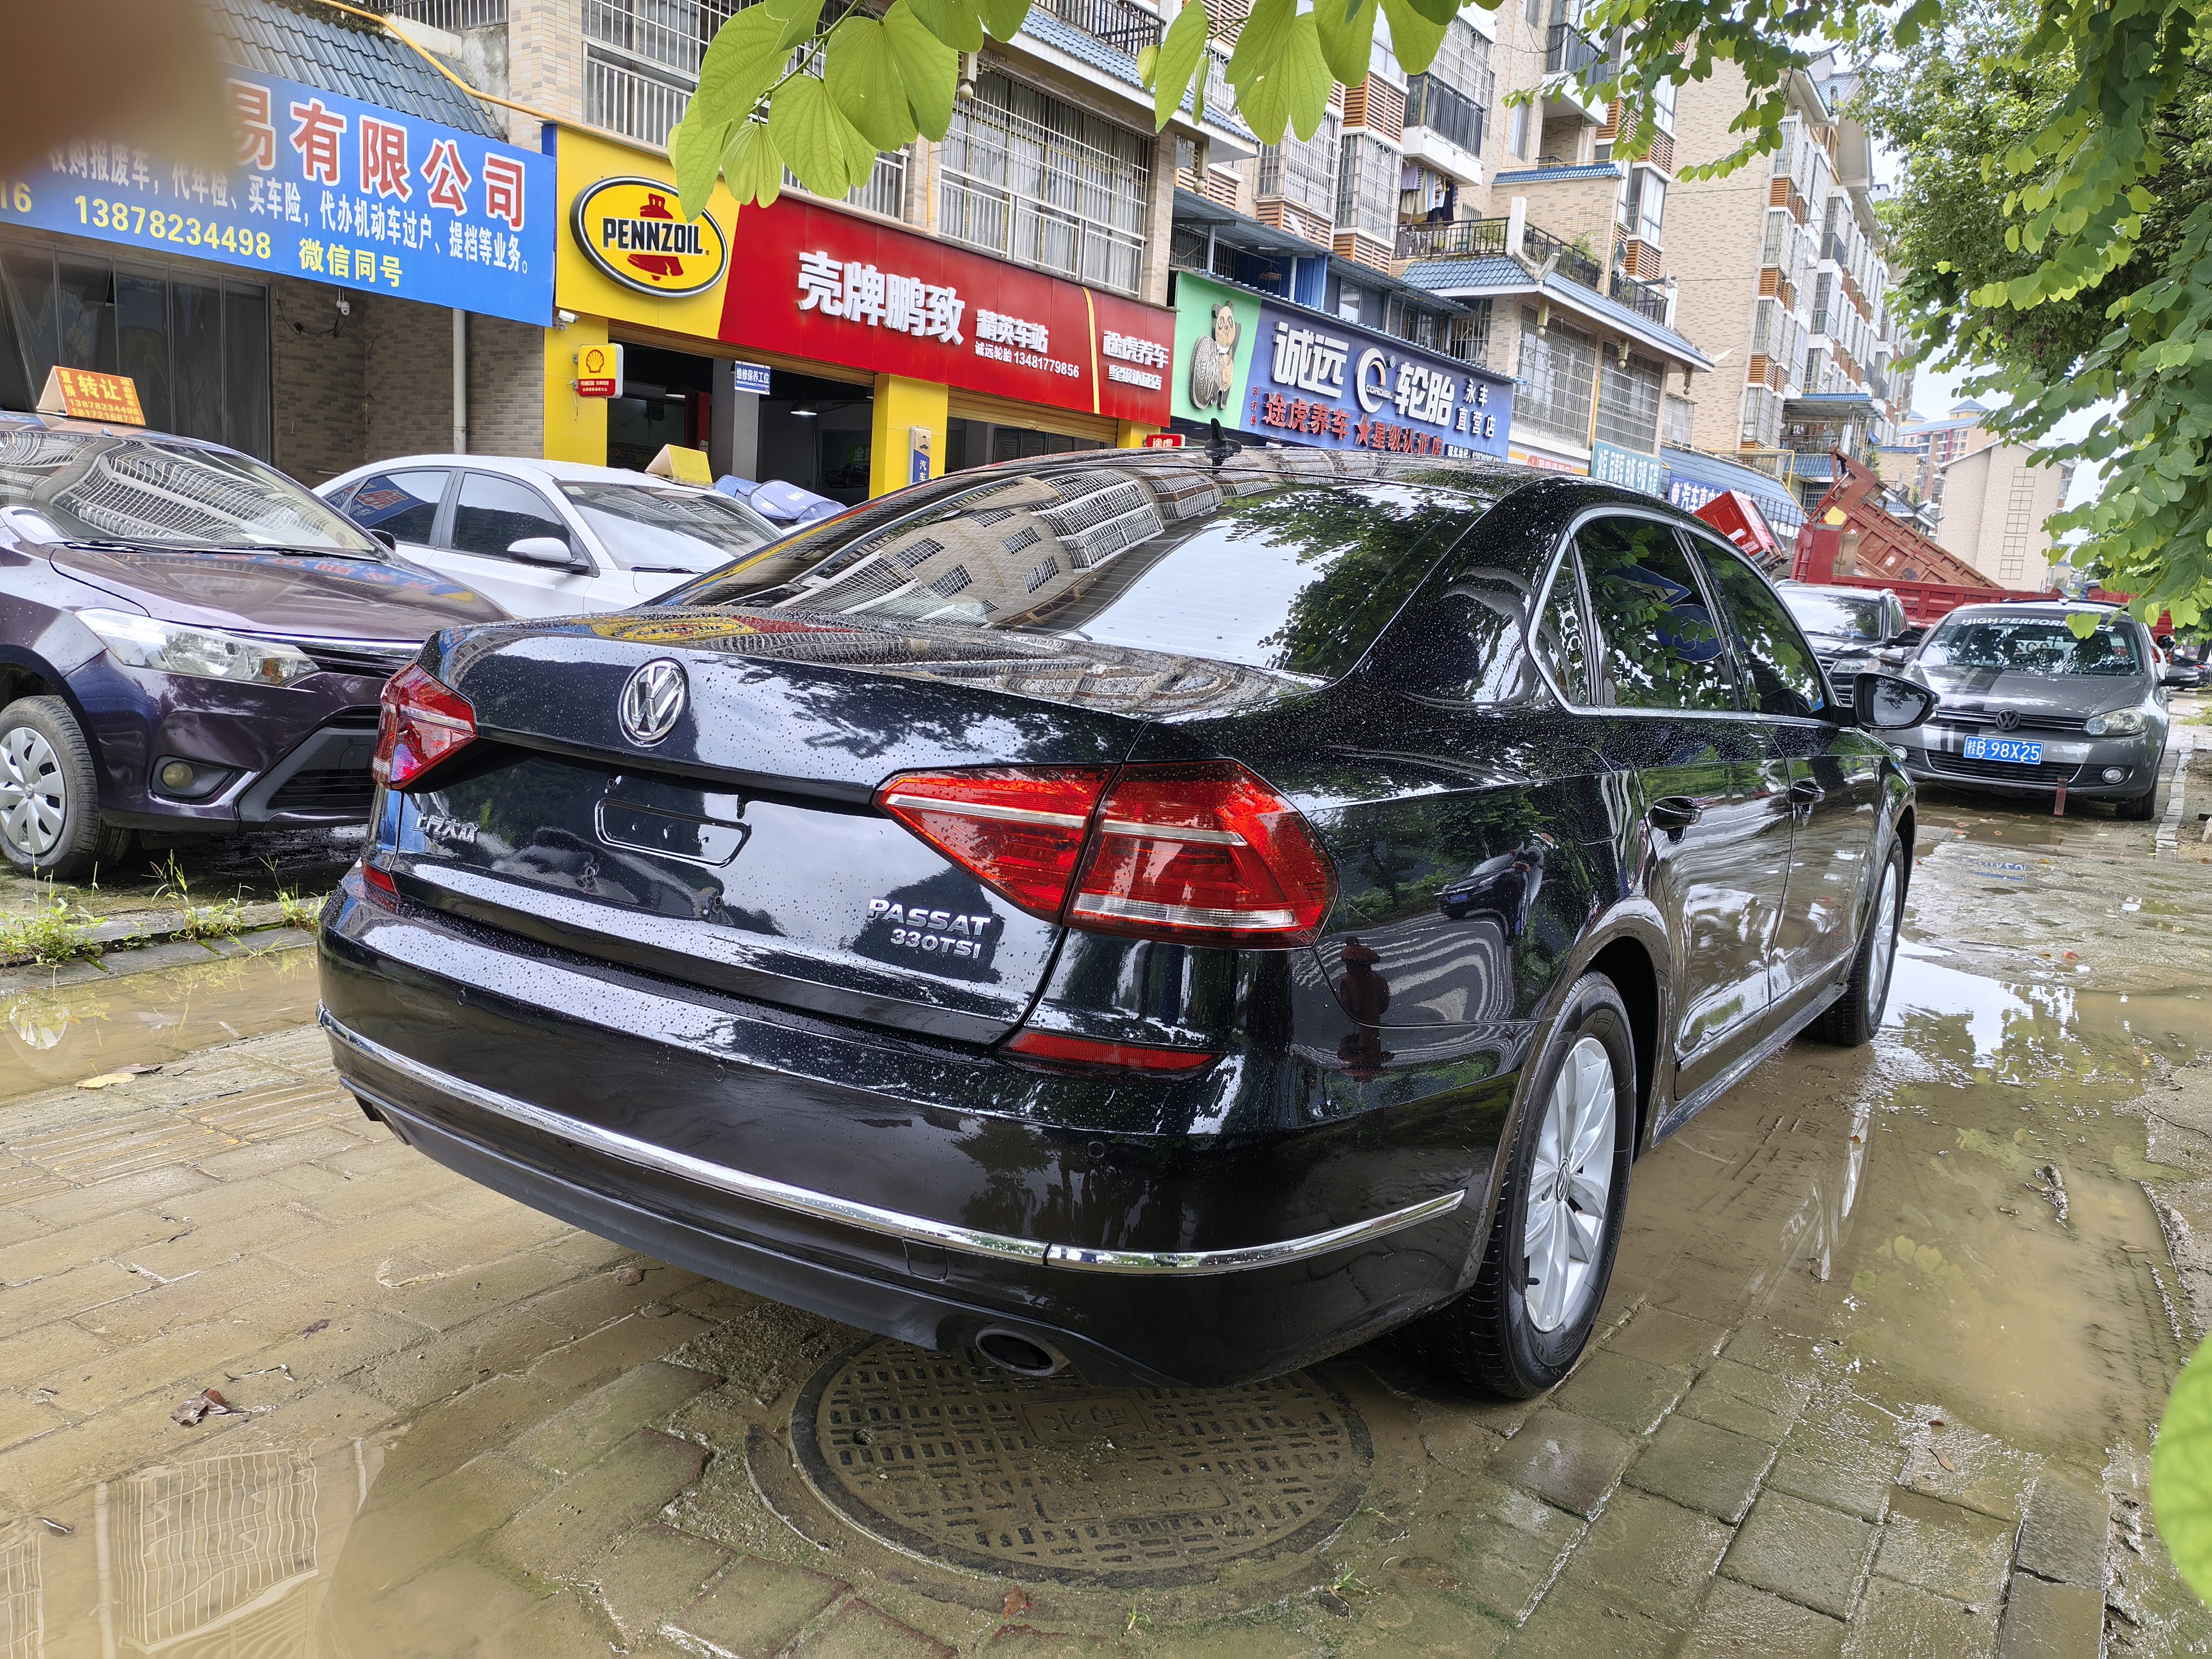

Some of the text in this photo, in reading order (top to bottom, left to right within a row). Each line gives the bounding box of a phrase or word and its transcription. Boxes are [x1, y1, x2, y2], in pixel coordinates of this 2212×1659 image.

[229, 77, 525, 231] 易有限公司
[75, 195, 271, 259] 13878234498
[603, 216, 703, 254] PENNZOIL
[299, 237, 402, 287] 微信同号
[797, 251, 966, 346] 壳牌鹏致
[976, 309, 1049, 353] 精英车站
[1103, 330, 1170, 368] 途虎养车
[736, 367, 770, 384] 维修保养工位
[975, 341, 1080, 378] 诚远轮胎 13481779856
[1272, 321, 1455, 426] 诚远 轮胎
[77, 374, 122, 401] 转让
[1464, 378, 1488, 407] 永丰
[69, 399, 139, 415] 13878234498
[1263, 392, 1444, 456] 途虎养车 星级认证店
[1456, 407, 1496, 438] 直营店
[919, 460, 927, 481] 汽车
[2000, 618, 2116, 632] PERFORCE
[412, 813, 478, 844] 上汽大众
[867, 899, 992, 936] PASSAT
[891, 928, 982, 959] 330TSI
